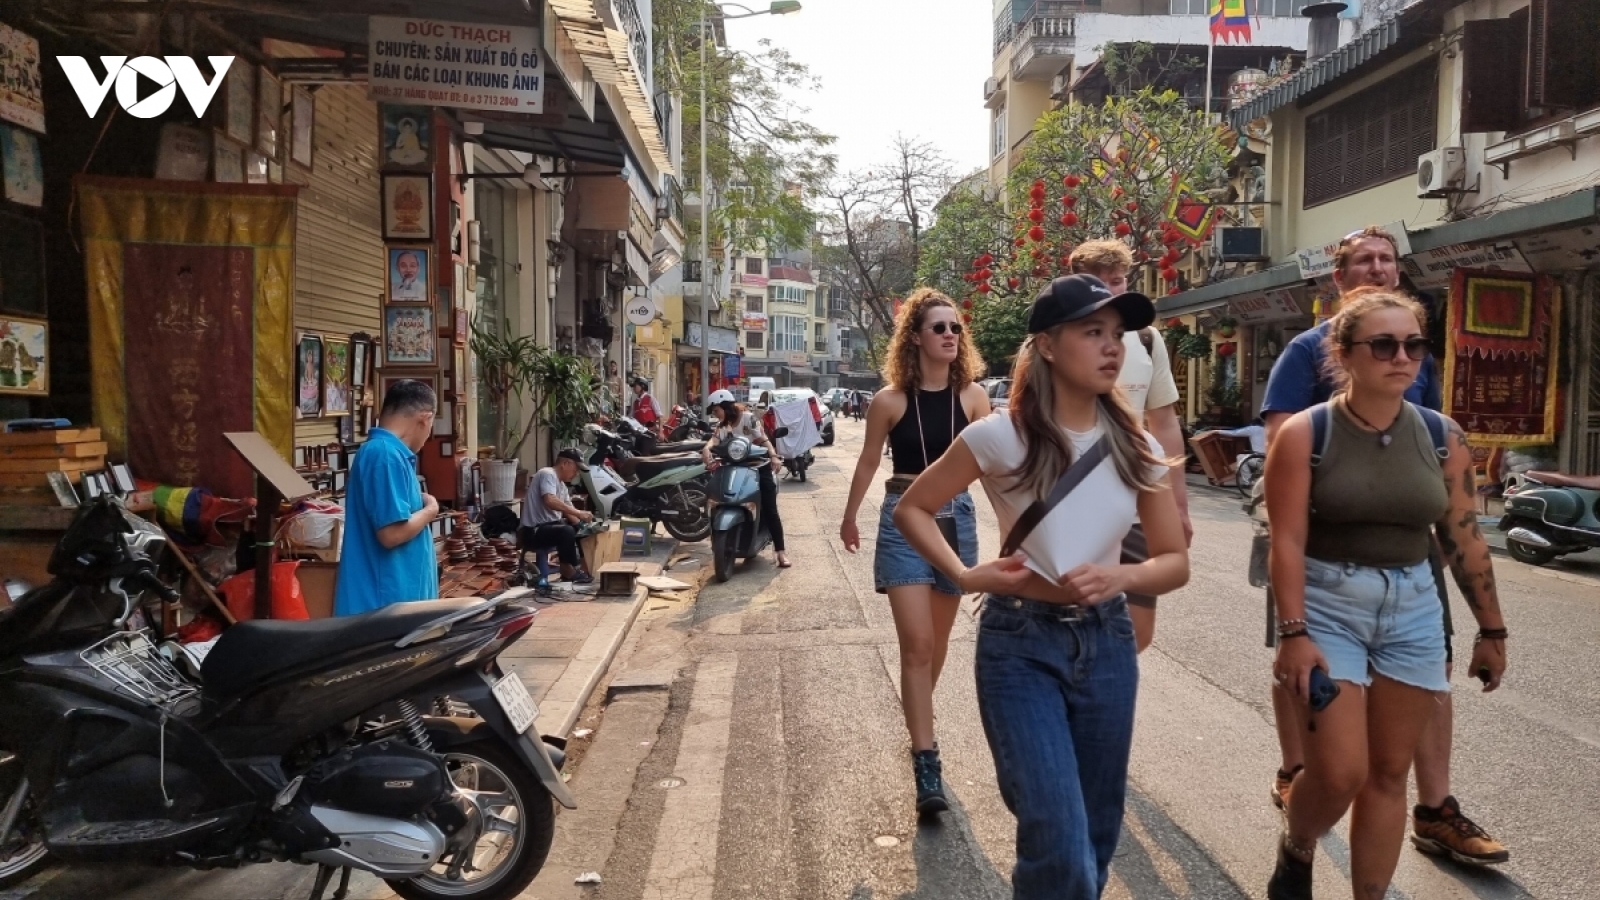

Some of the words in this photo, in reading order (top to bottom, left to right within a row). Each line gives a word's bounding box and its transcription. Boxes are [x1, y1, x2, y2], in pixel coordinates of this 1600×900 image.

[405, 20, 445, 37] ĐỨC
[450, 26, 511, 44] THẠCH
[375, 40, 430, 60] CHUYÊN:
[434, 41, 461, 63] SẢN
[464, 44, 497, 66] XUẤT
[521, 48, 538, 69] GỖ
[373, 60, 400, 80] BÁN
[404, 63, 430, 82] CÁC
[433, 67, 462, 88] LOẠI
[466, 71, 509, 89] KHUNG
[512, 69, 539, 91] ẢNH
[393, 87, 403, 97] 37
